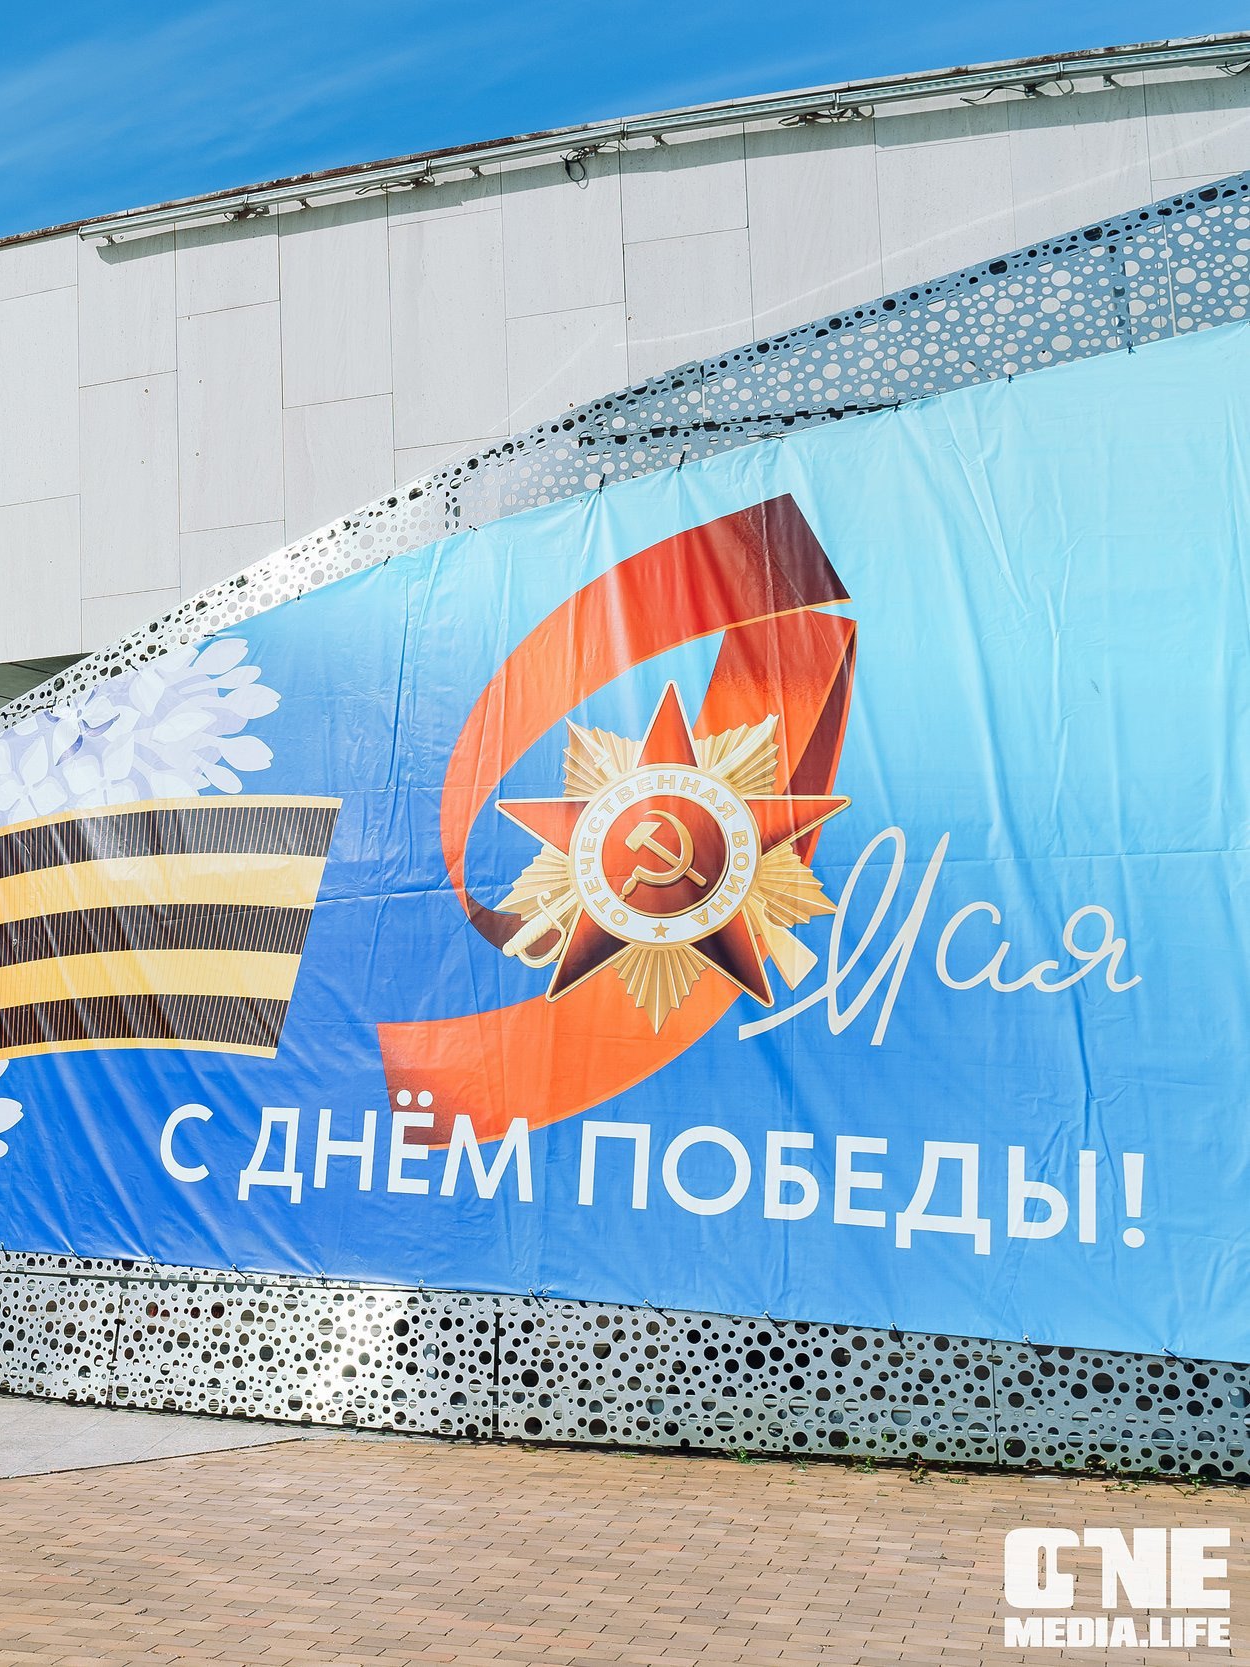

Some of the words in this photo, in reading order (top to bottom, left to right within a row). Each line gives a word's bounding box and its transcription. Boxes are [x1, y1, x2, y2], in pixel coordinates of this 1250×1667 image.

[575, 774, 739, 928] ОТЕЧЕСТВЕННАЯ
[690, 828, 751, 928] ВОЙНА
[738, 826, 1143, 1046] Мая
[159, 1103, 212, 1184] С
[237, 1090, 534, 1205] ДНЁМ
[576, 1120, 1147, 1256] ПОБЕДЫ!
